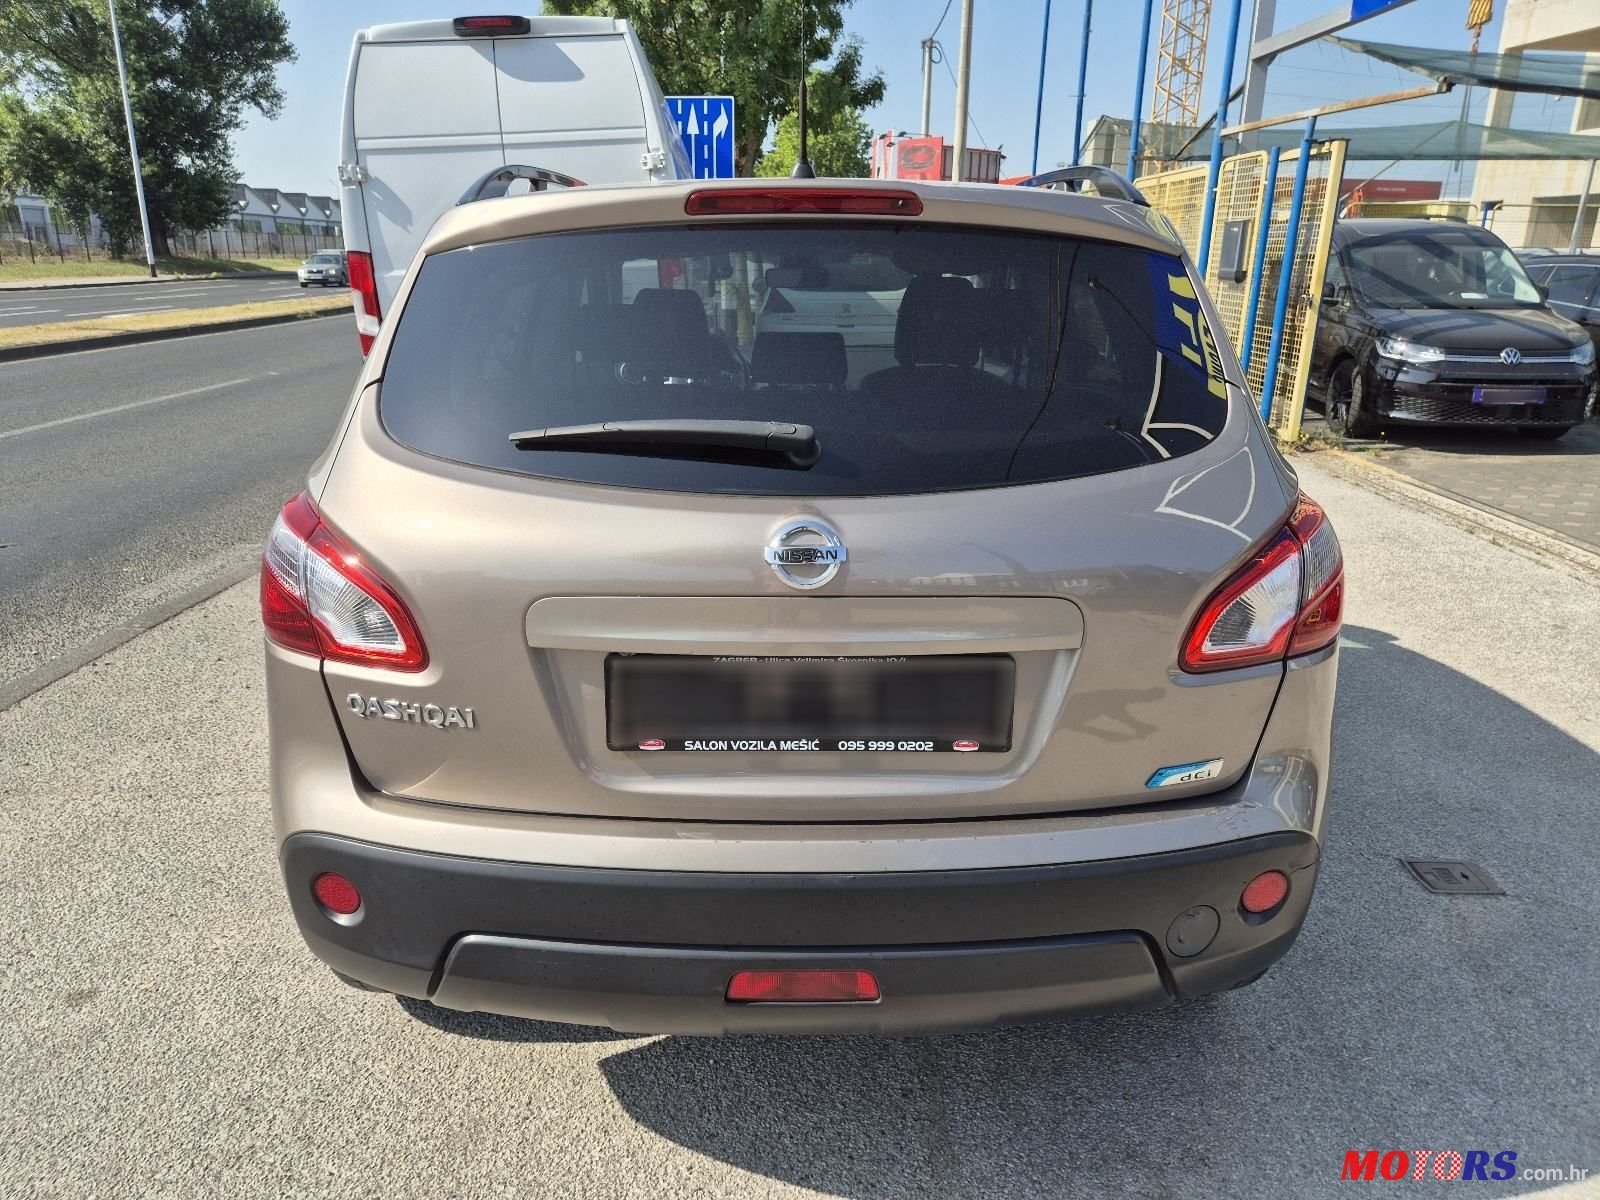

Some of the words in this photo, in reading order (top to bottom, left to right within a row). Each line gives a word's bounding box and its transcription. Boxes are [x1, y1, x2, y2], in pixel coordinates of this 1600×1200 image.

[773, 549, 838, 563] NISSAN
[346, 692, 475, 728] QASHQAI
[684, 740, 728, 751] SALON
[730, 740, 777, 751] VOZILA
[780, 738, 820, 751] MEŠIĆ
[838, 740, 865, 751] 095
[868, 740, 895, 751] 999
[898, 741, 934, 751] 0202
